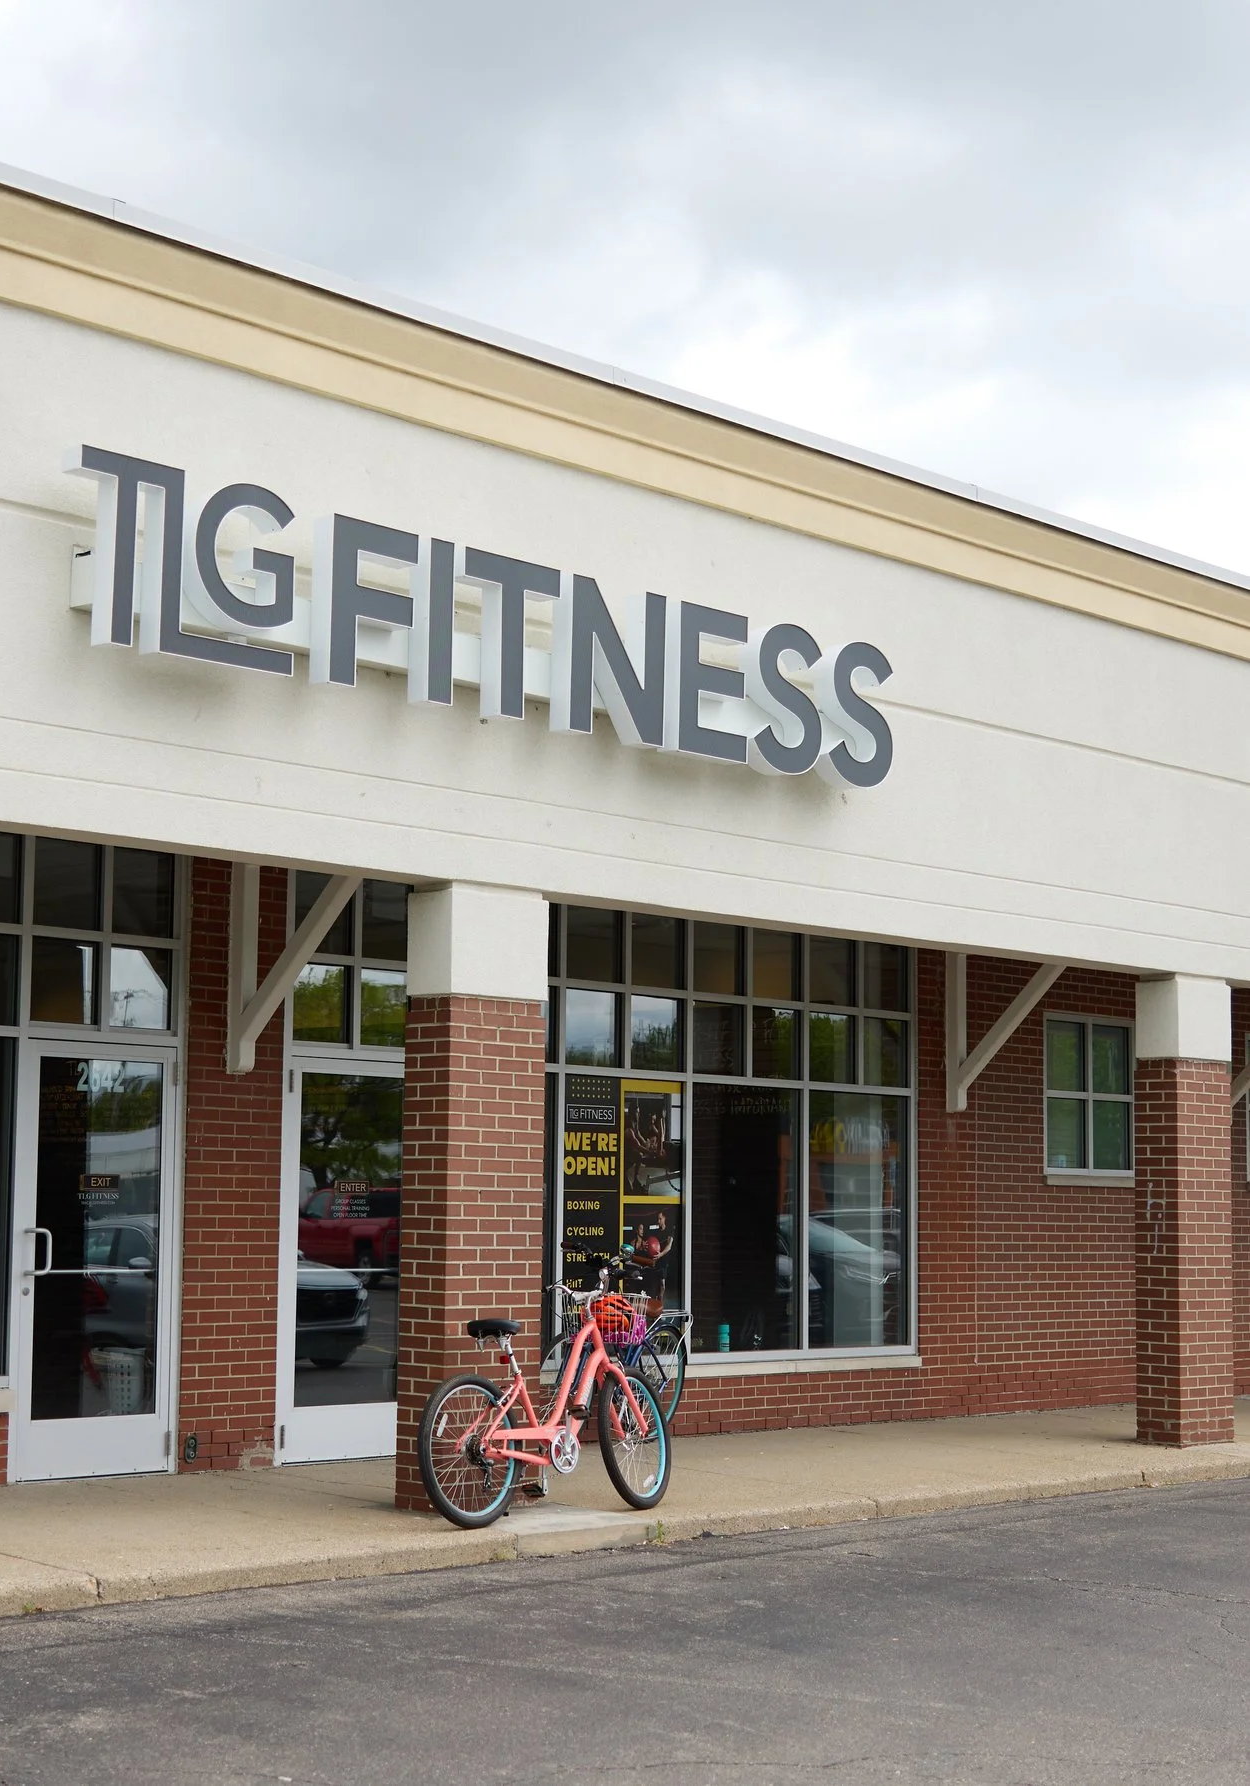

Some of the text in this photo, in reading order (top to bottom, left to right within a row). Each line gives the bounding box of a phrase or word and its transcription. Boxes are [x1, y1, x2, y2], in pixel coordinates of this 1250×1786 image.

[78, 444, 895, 789] TLG FITNESS
[579, 1108, 613, 1120] FITNESS
[564, 1131, 618, 1152] WE'RE
[564, 1156, 616, 1176] OPEN!
[91, 1177, 111, 1187] EXIT
[340, 1183, 367, 1192] ENTER
[566, 1200, 600, 1210] BOXING
[566, 1226, 604, 1236] CYCLING
